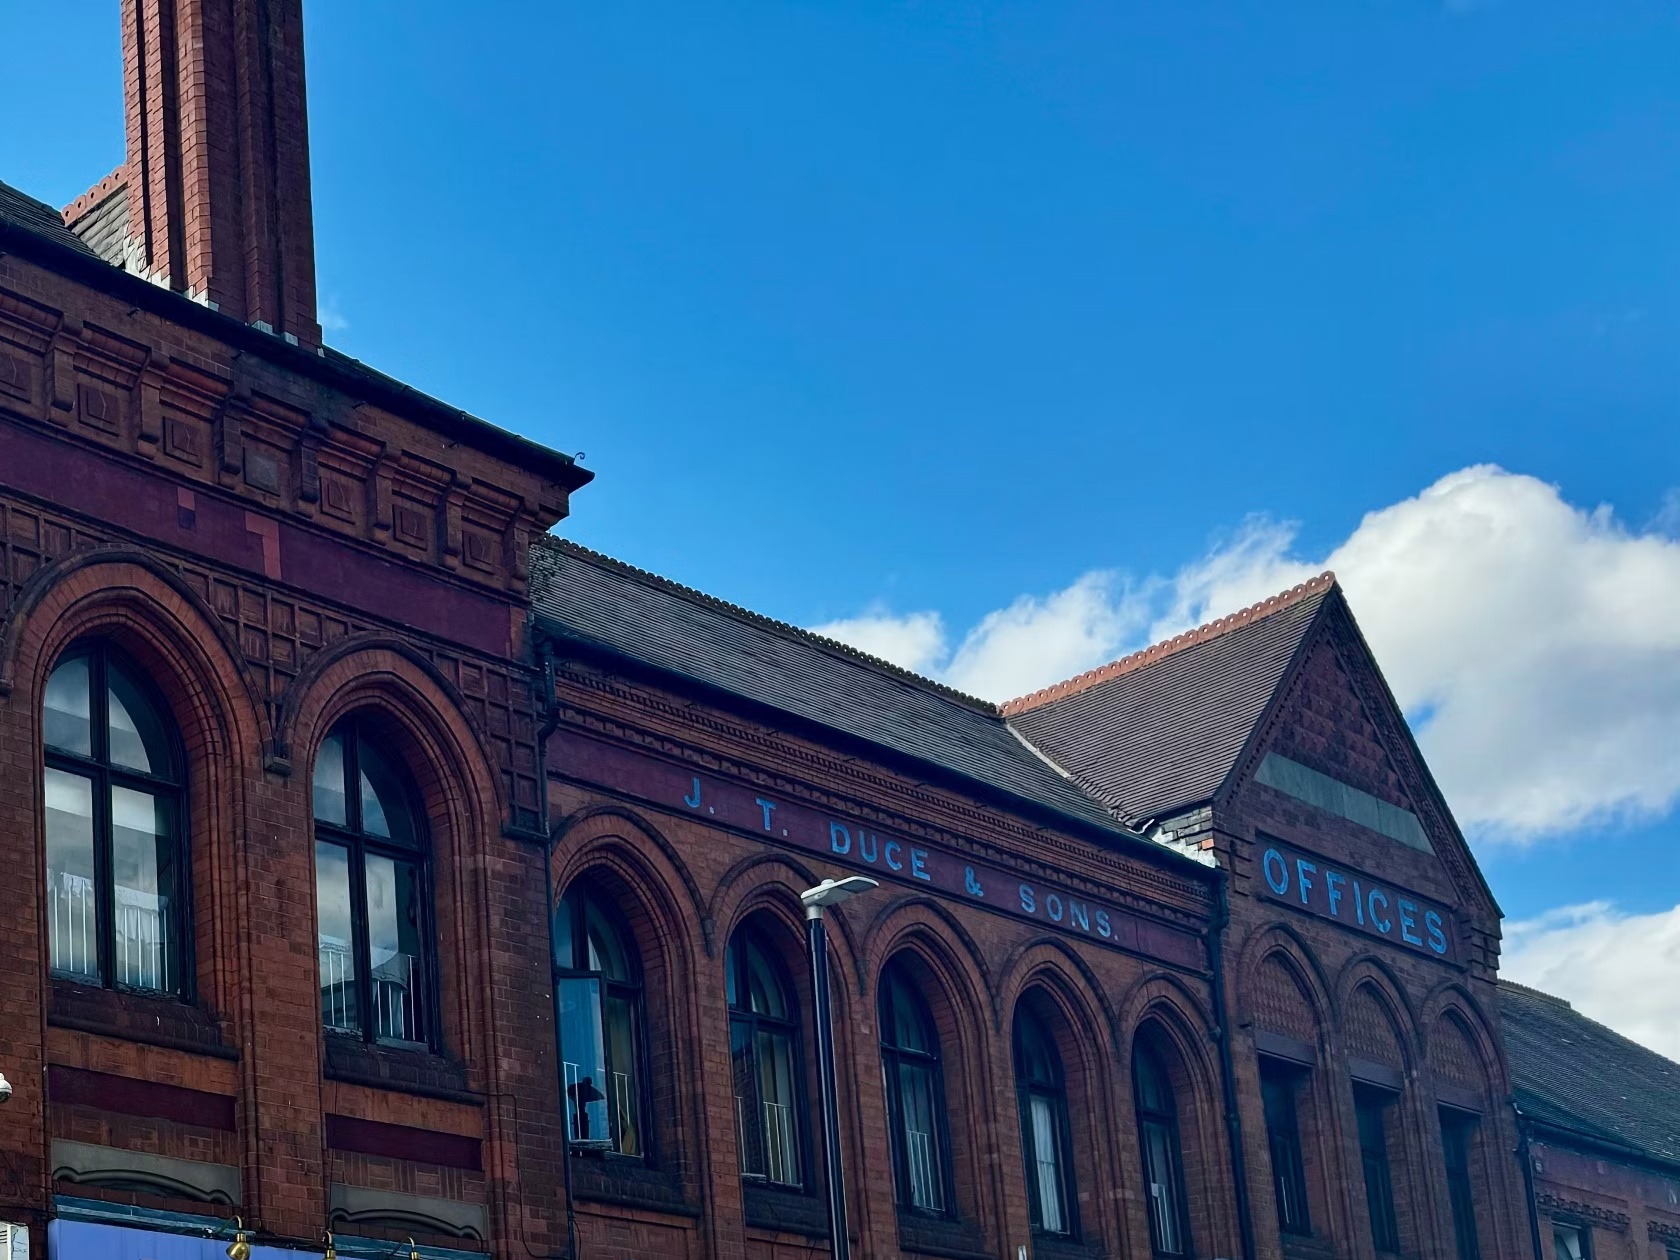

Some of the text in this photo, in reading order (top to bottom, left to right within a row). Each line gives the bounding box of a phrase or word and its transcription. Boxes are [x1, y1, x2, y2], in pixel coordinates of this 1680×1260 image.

[683, 777, 715, 815] J.
[755, 796, 789, 837] T.
[829, 820, 932, 882] DUCE
[965, 865, 985, 898] &
[1262, 847, 1448, 955] OFFICES
